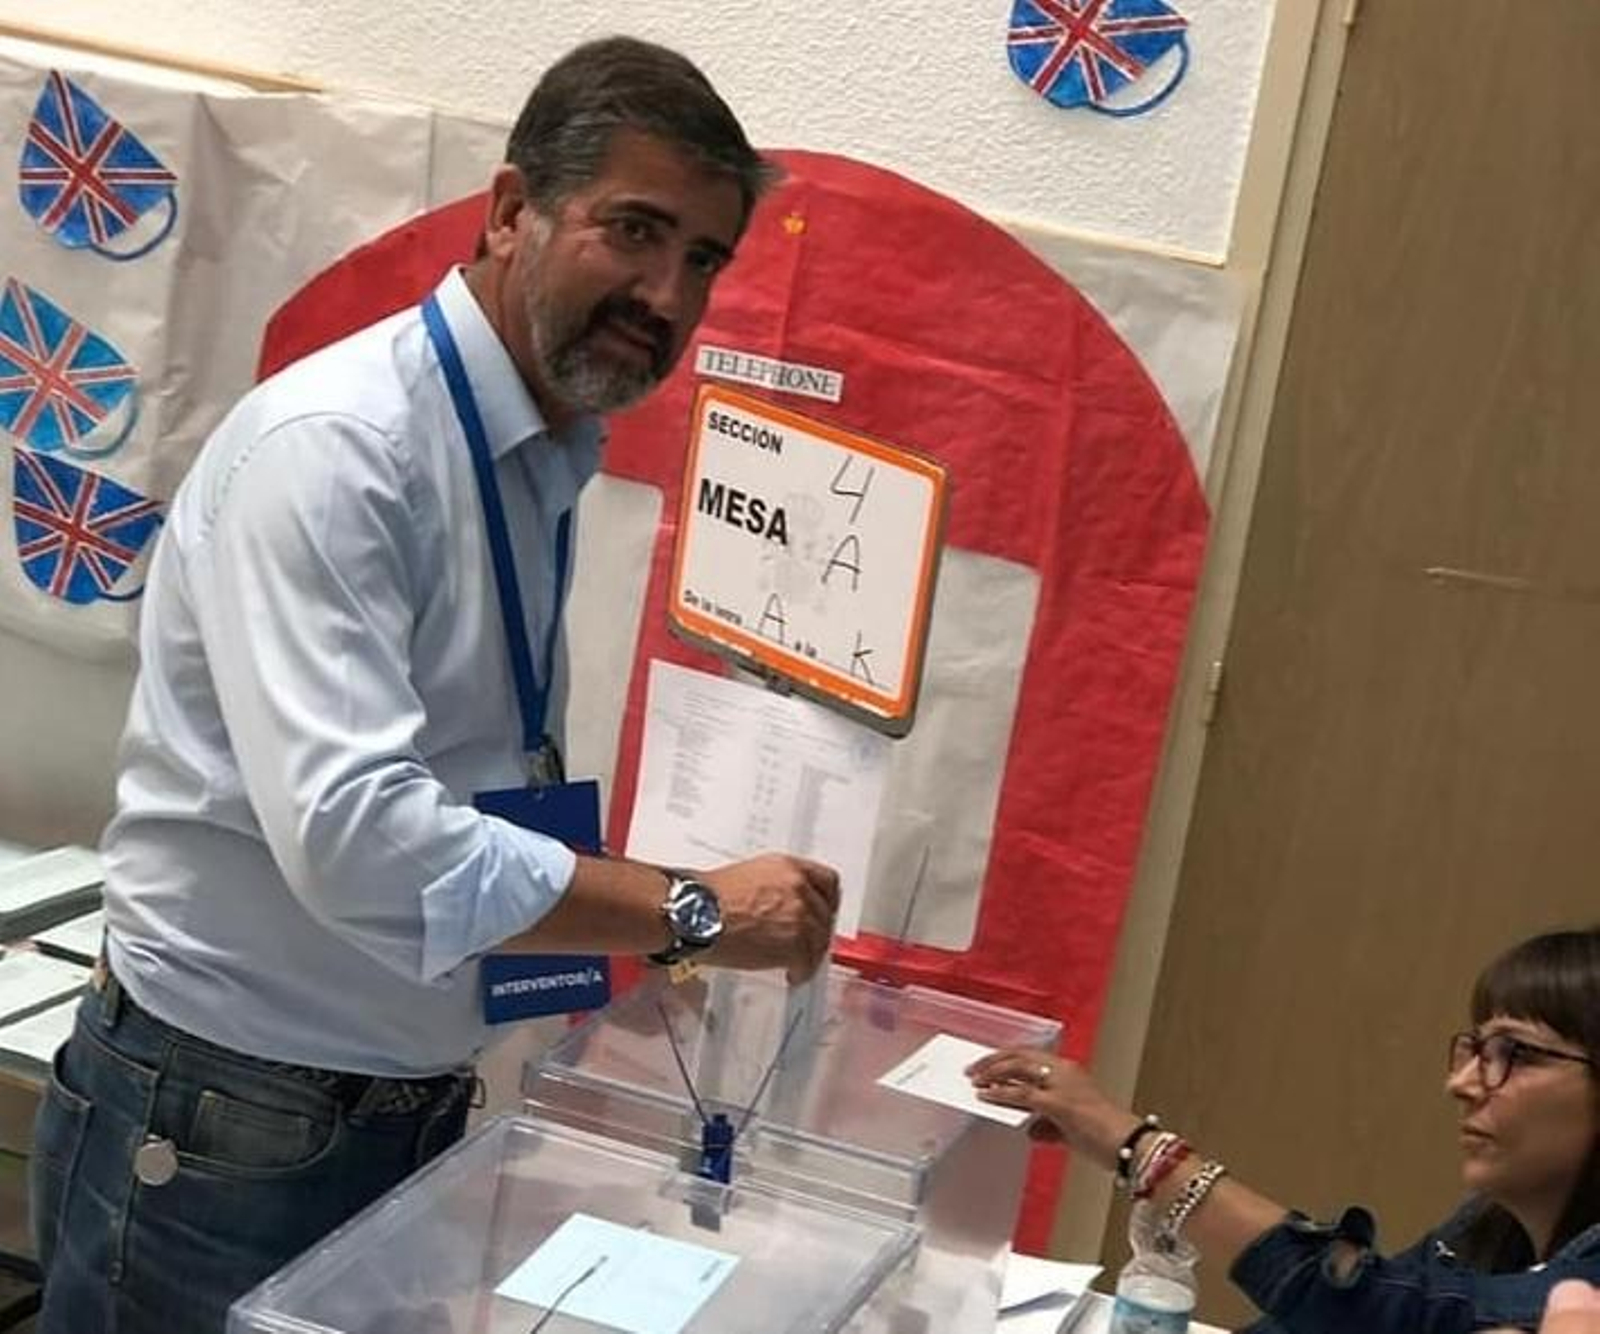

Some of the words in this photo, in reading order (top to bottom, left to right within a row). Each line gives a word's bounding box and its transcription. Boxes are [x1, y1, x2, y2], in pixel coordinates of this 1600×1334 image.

[700, 348, 838, 397] TELEPHONE
[698, 477, 788, 546] MESA
[829, 455, 875, 525] 4
[820, 533, 862, 592] A
[757, 592, 786, 646] A
[491, 967, 603, 997] INTERVENTOR/A
